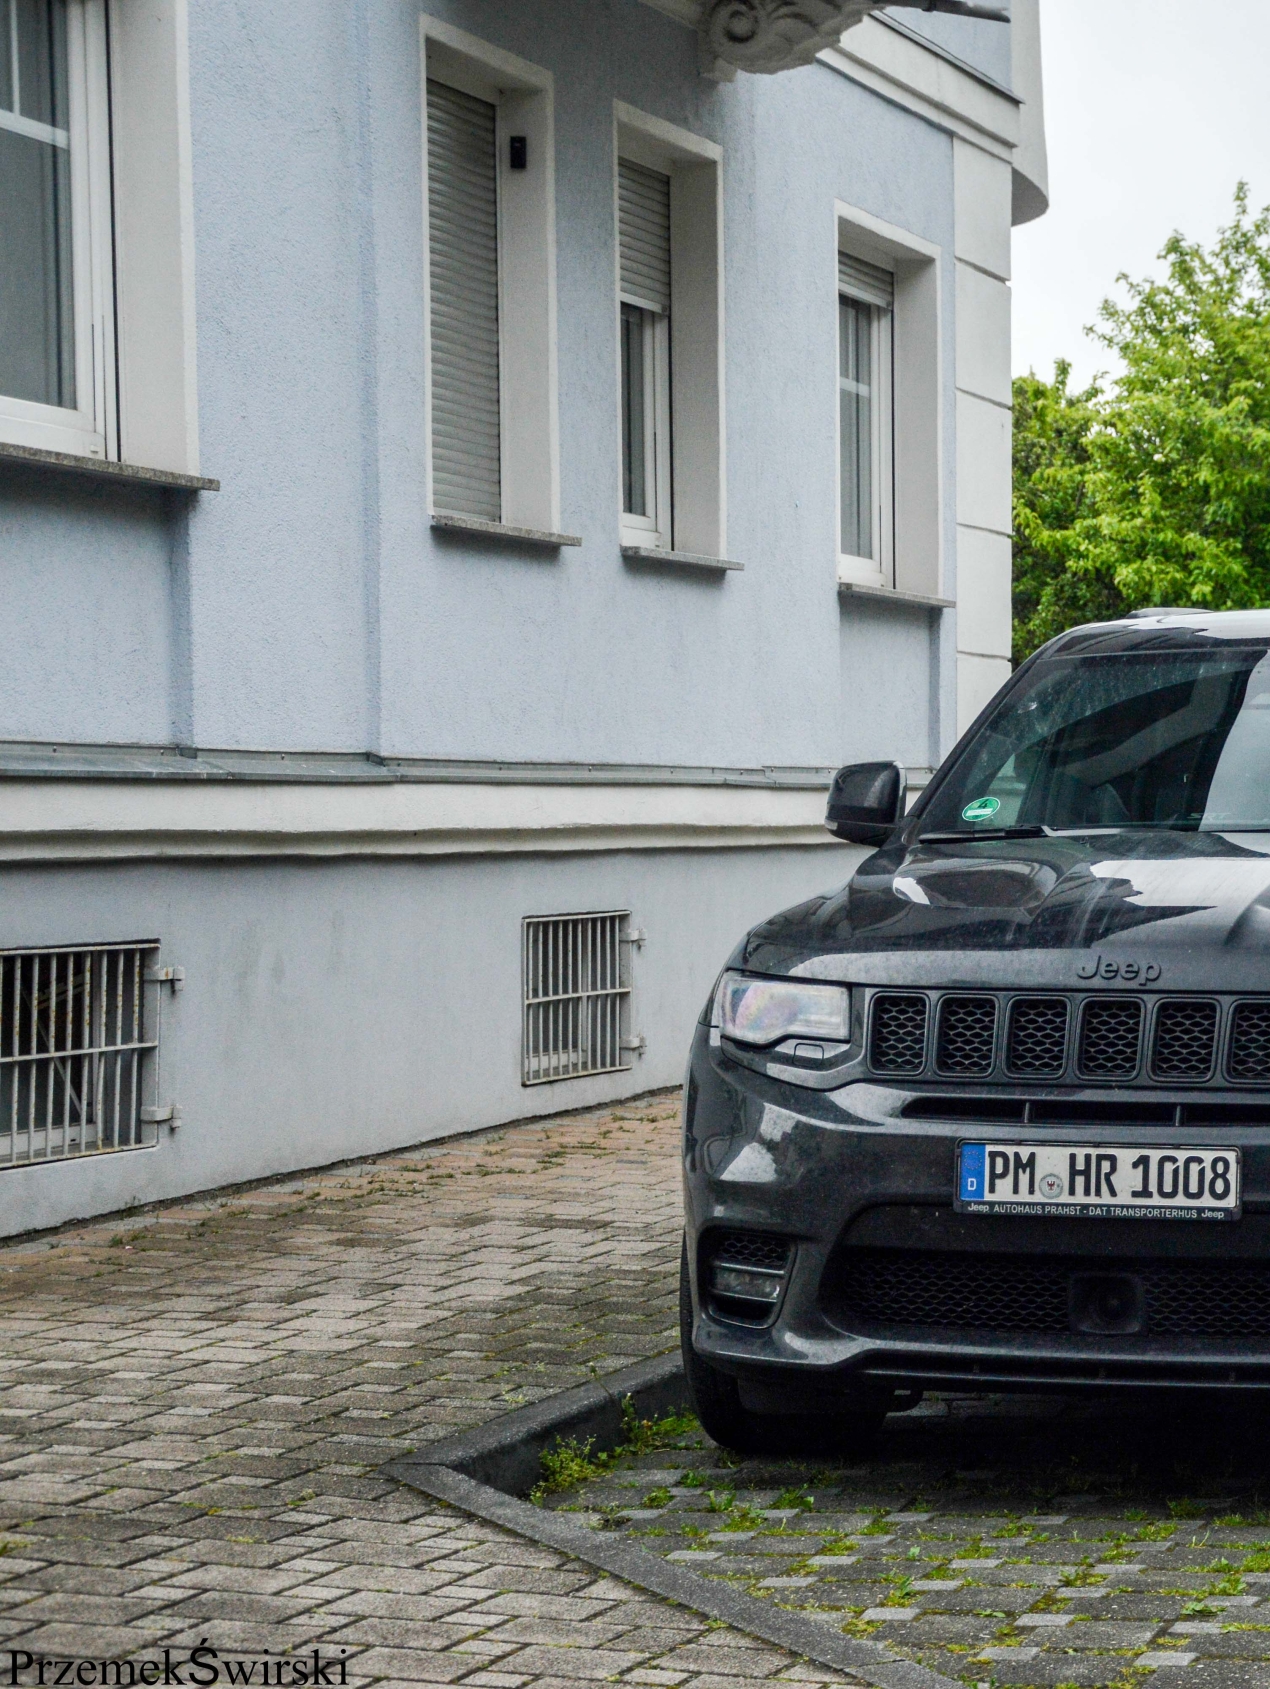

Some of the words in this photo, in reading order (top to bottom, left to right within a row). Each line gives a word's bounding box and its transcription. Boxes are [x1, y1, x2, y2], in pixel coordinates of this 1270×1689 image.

[1077, 955, 1162, 986] Jeep
[967, 1178, 977, 1191] D
[988, 1150, 1036, 1195] PM
[1068, 1153, 1118, 1197] HR
[1131, 1154, 1231, 1201] 1008
[967, 1203, 989, 1212] Jeep
[993, 1204, 1042, 1213] AUTOHAUS
[1044, 1206, 1081, 1215] PRAHST
[1089, 1207, 1107, 1215] DAT
[1110, 1207, 1197, 1217] TRANSPORTERHUS
[1201, 1209, 1225, 1218] Jeep
